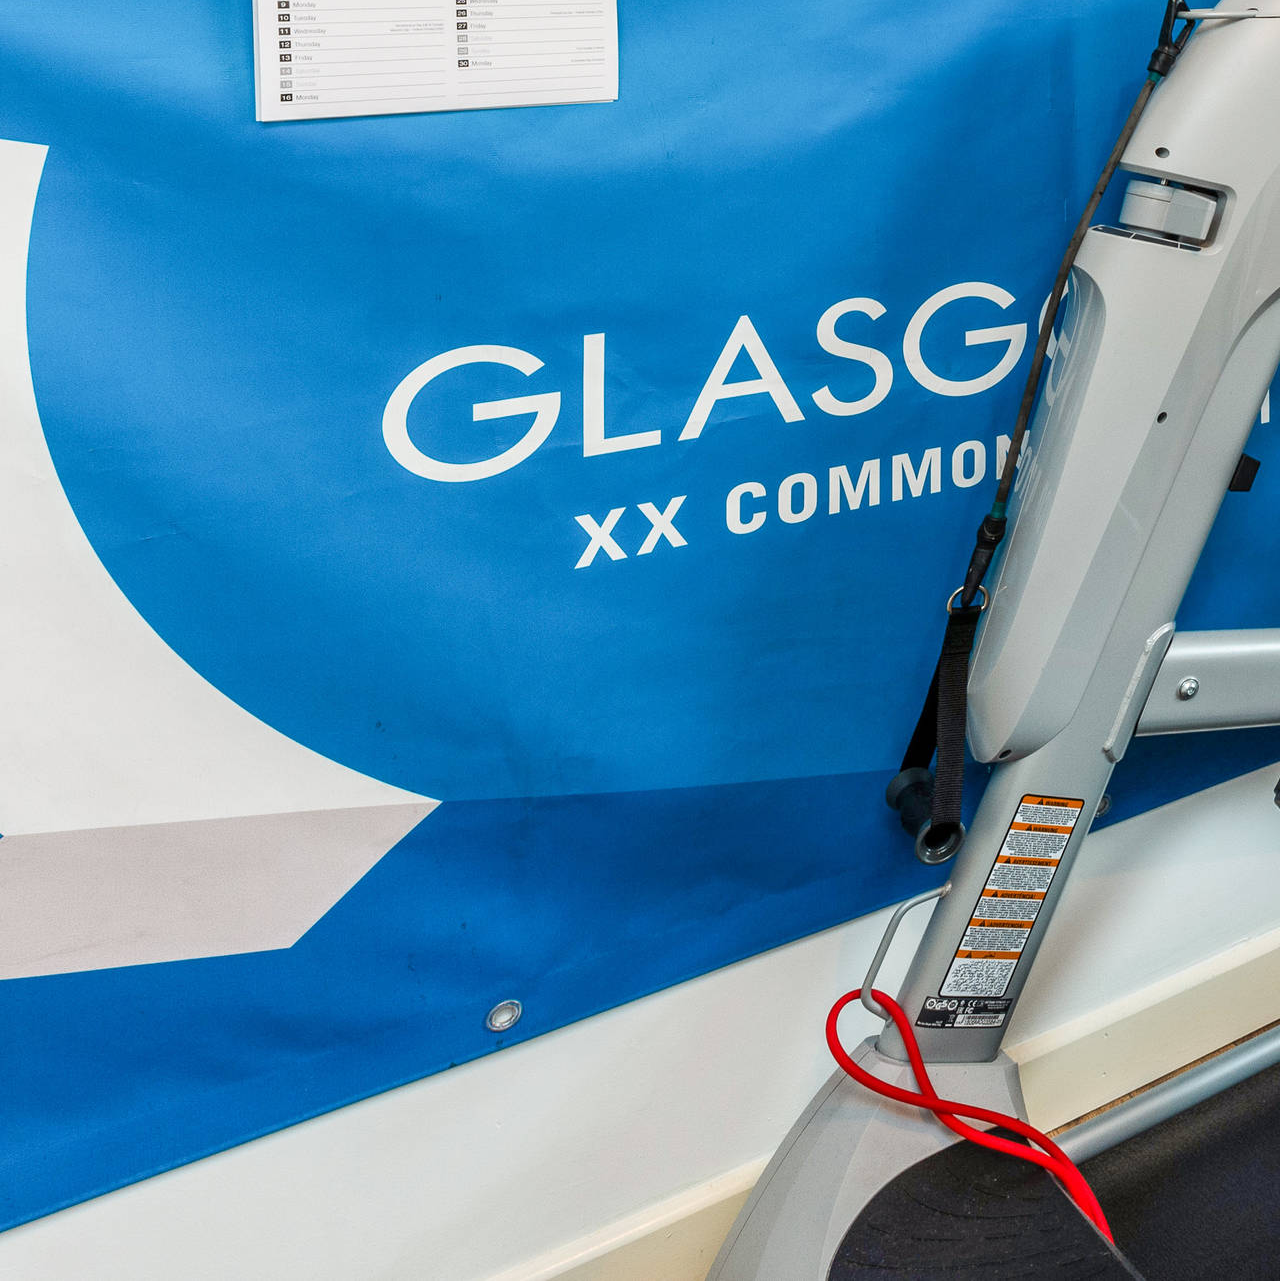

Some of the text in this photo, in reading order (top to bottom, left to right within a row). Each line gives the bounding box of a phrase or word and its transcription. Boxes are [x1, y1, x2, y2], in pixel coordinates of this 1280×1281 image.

[382, 281, 1070, 483] GLASG
[574, 495, 688, 569] XX
[726, 429, 1031, 535] COMMON
